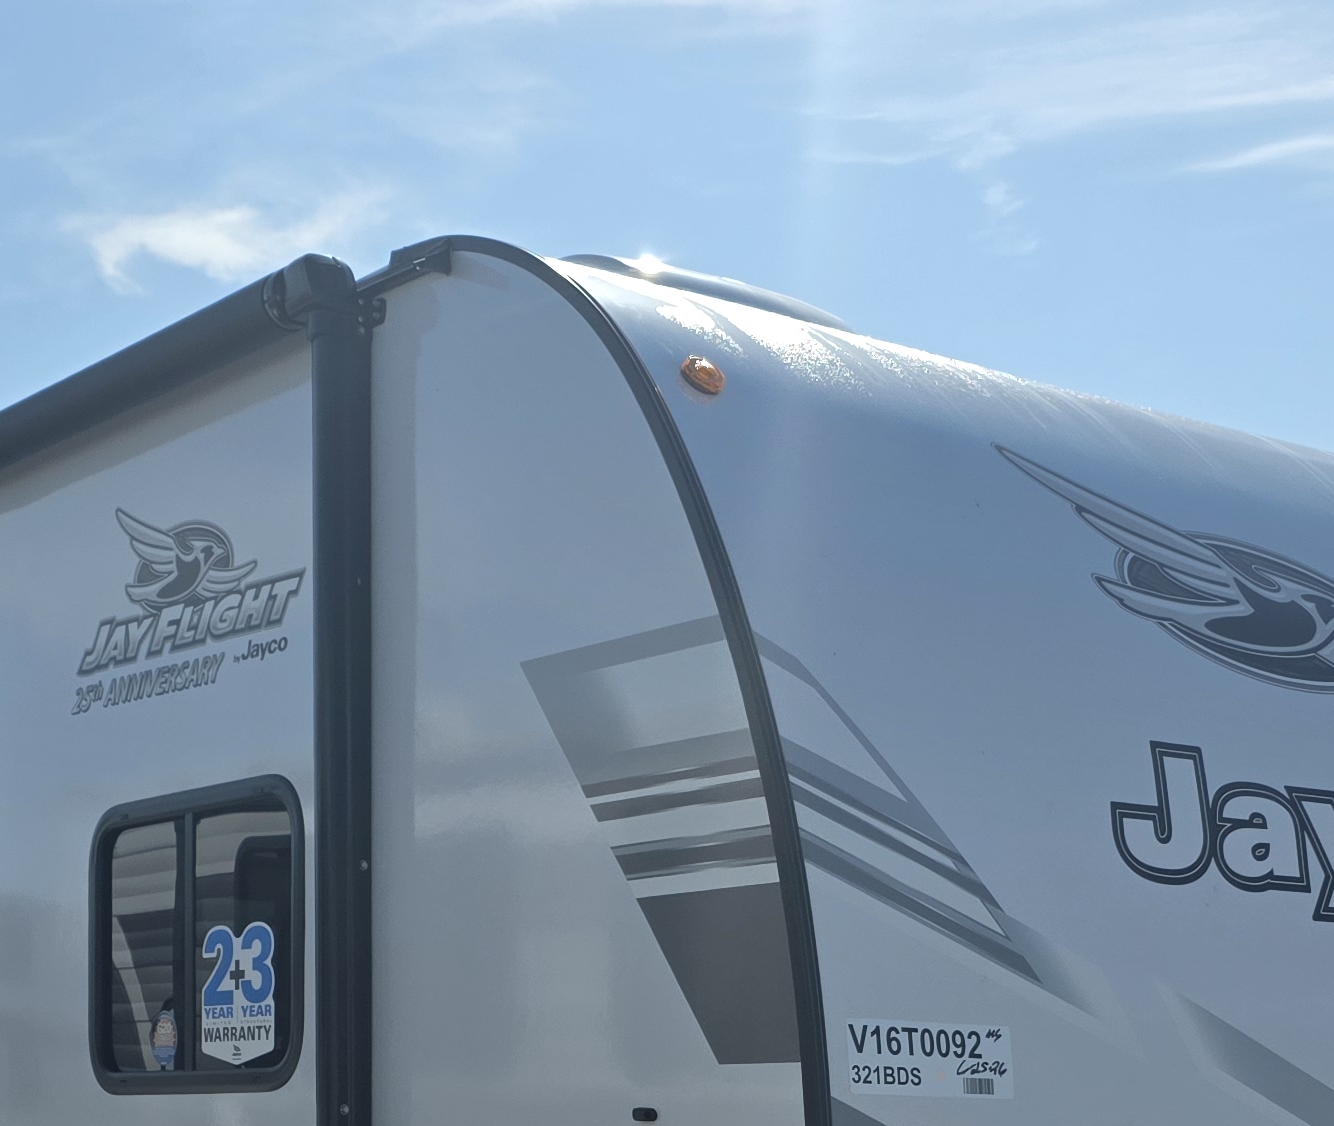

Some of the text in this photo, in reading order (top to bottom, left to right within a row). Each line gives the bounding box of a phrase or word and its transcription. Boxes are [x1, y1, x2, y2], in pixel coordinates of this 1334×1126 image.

[241, 636, 288, 661] Jayco
[71, 652, 225, 715] 25th ANNIVERSARY
[204, 1005, 272, 1020] YEAR YEAR
[204, 1025, 272, 1043] WARRANTY
[848, 1023, 983, 1059] V16T0092
[851, 1065, 922, 1086] 321BDS
